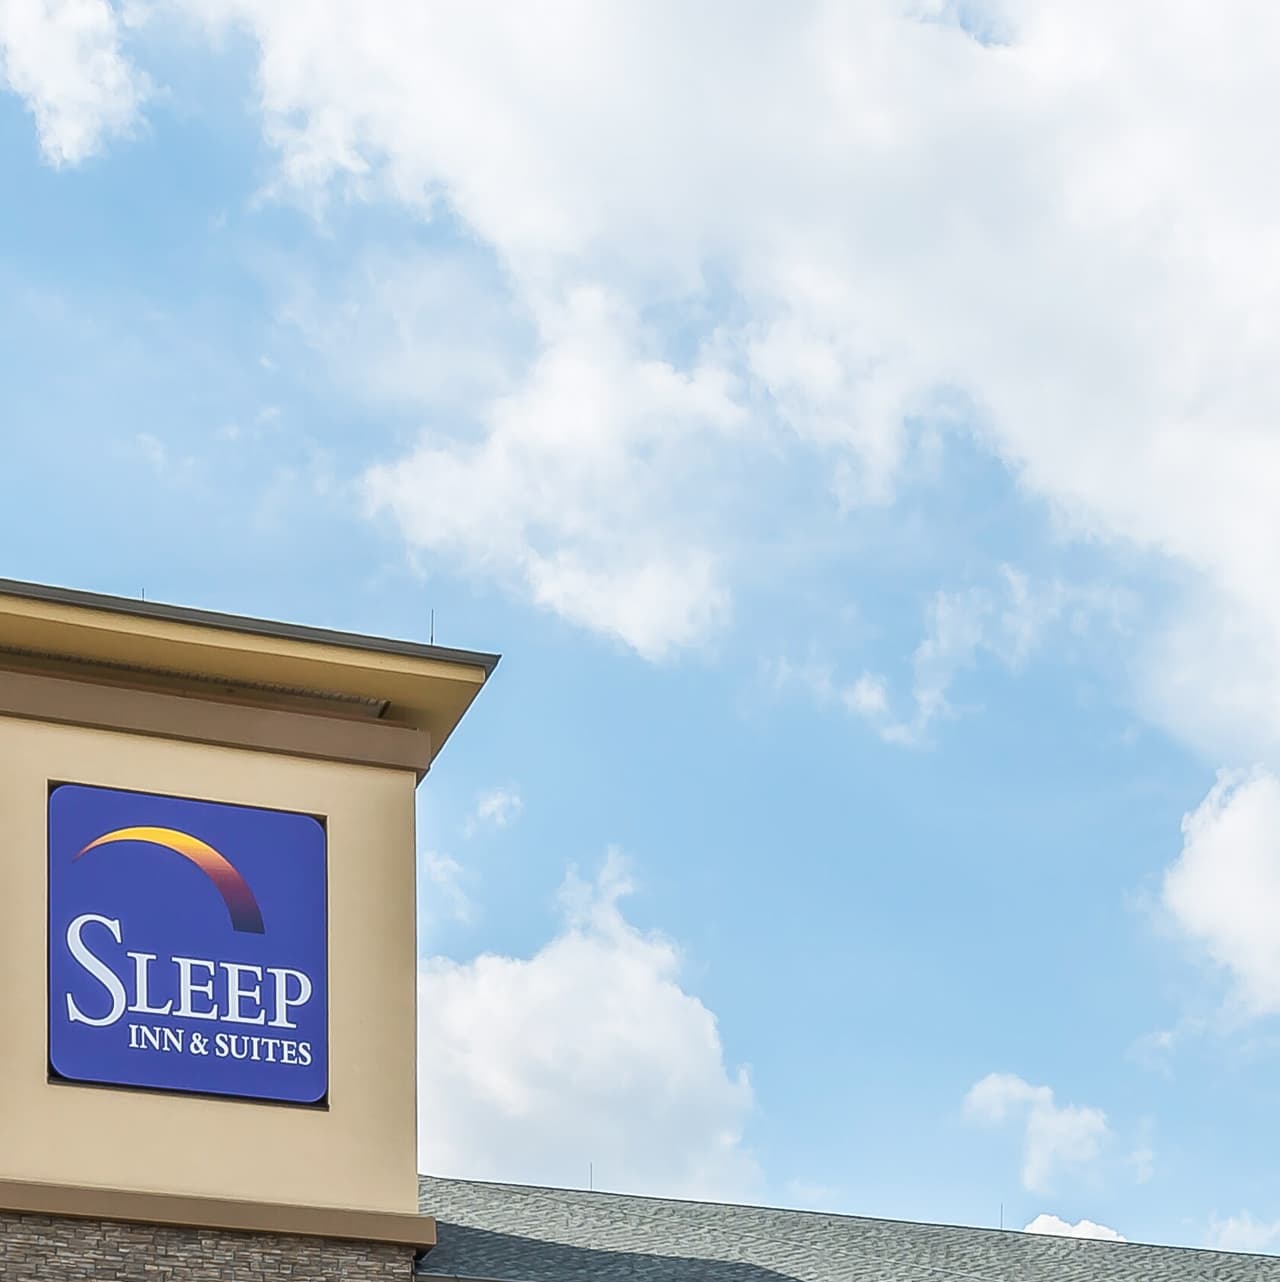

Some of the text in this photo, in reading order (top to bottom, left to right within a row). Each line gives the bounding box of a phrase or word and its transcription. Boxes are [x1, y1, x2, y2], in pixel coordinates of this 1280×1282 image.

[66, 912, 313, 1029] SLEEP
[127, 1023, 313, 1066] INN & SUITES
